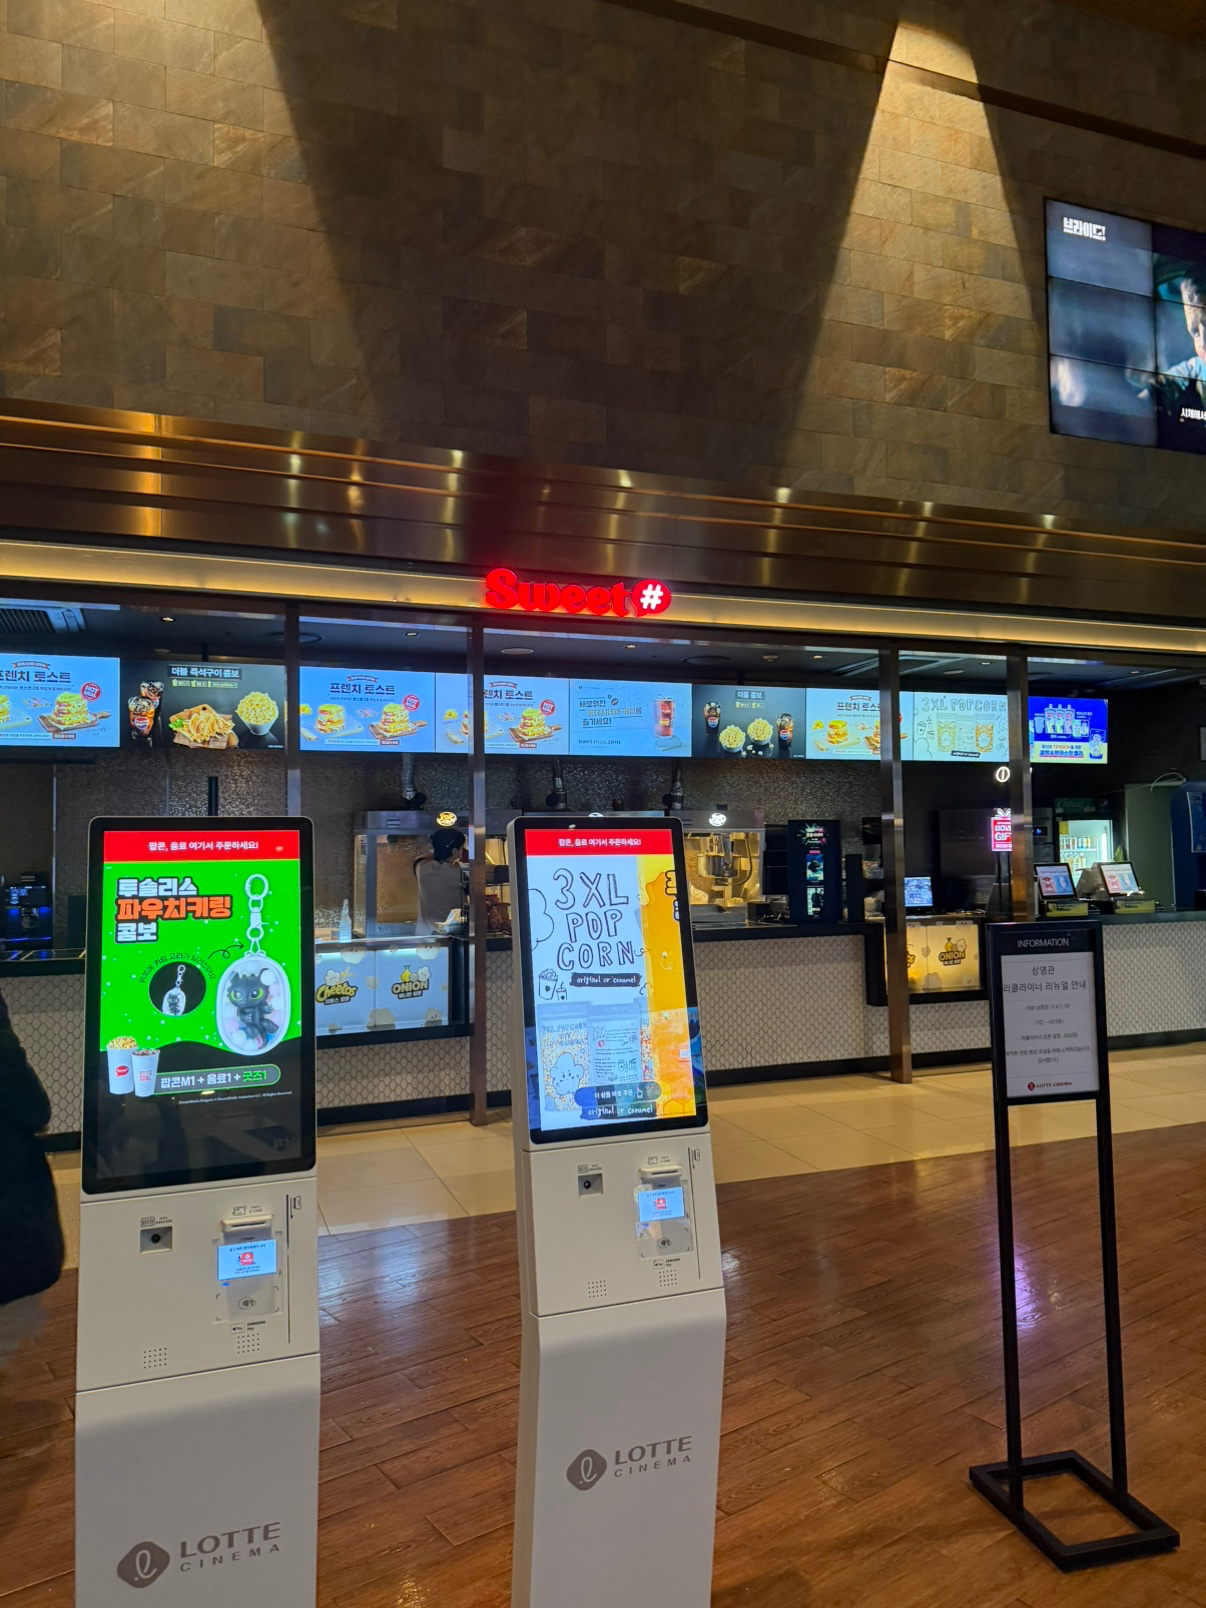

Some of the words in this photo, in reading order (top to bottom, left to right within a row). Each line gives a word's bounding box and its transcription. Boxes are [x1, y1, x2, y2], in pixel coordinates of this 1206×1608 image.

[485, 567, 629, 617] Sweet
[34, 671, 71, 683] 토스트
[171, 667, 188, 677] 더블
[190, 668, 222, 678] 즉석구이
[223, 669, 240, 678] 콤보
[330, 683, 361, 694] 프렌치
[364, 684, 395, 695] 토스트
[484, 689, 502, 699] 렌치
[505, 690, 533, 700] 토스트
[837, 702, 860, 711] 프렌치
[862, 702, 880, 711] 토스
[922, 697, 948, 712] 3XL
[950, 698, 1006, 712] POPCORN
[149, 842, 168, 852] 팝콘,
[170, 842, 186, 850] 음료
[189, 841, 214, 850] 여기서
[215, 841, 259, 850] 주문하세요!
[558, 838, 574, 847] 팝콘,
[574, 838, 588, 846] 음료
[588, 838, 608, 846] 여기서
[608, 838, 642, 846] 주문하세요!
[117, 877, 198, 897] 투슬리스
[553, 868, 630, 911] 3XL
[117, 896, 232, 920] 파우치키링
[117, 922, 158, 942] 콤보
[565, 909, 623, 943] POP
[1017, 938, 1070, 948] INFORMATION
[169, 952, 190, 960] 고리가
[557, 940, 635, 971] CORN
[939, 951, 965, 962] ONION
[1032, 965, 1055, 976] 상영관
[576, 976, 601, 984] original
[612, 975, 636, 983] caramel
[1003, 983, 1043, 993] 리클라이너
[1045, 981, 1069, 991] 리뉴얼
[1071, 980, 1087, 990] 안내
[316, 980, 358, 1003] Cheetos
[392, 980, 428, 995] ONION
[160, 1073, 195, 1089] 팝콘M1
[206, 1071, 232, 1085] 음료1
[243, 1069, 268, 1083] 굿즈1
[588, 1105, 614, 1118] original
[628, 1104, 653, 1114] caramel
[615, 1435, 692, 1465] LOTTE
[614, 1455, 691, 1478] CINEMA
[180, 1522, 280, 1558] LOTTE
[180, 1543, 280, 1572] CINEMA
